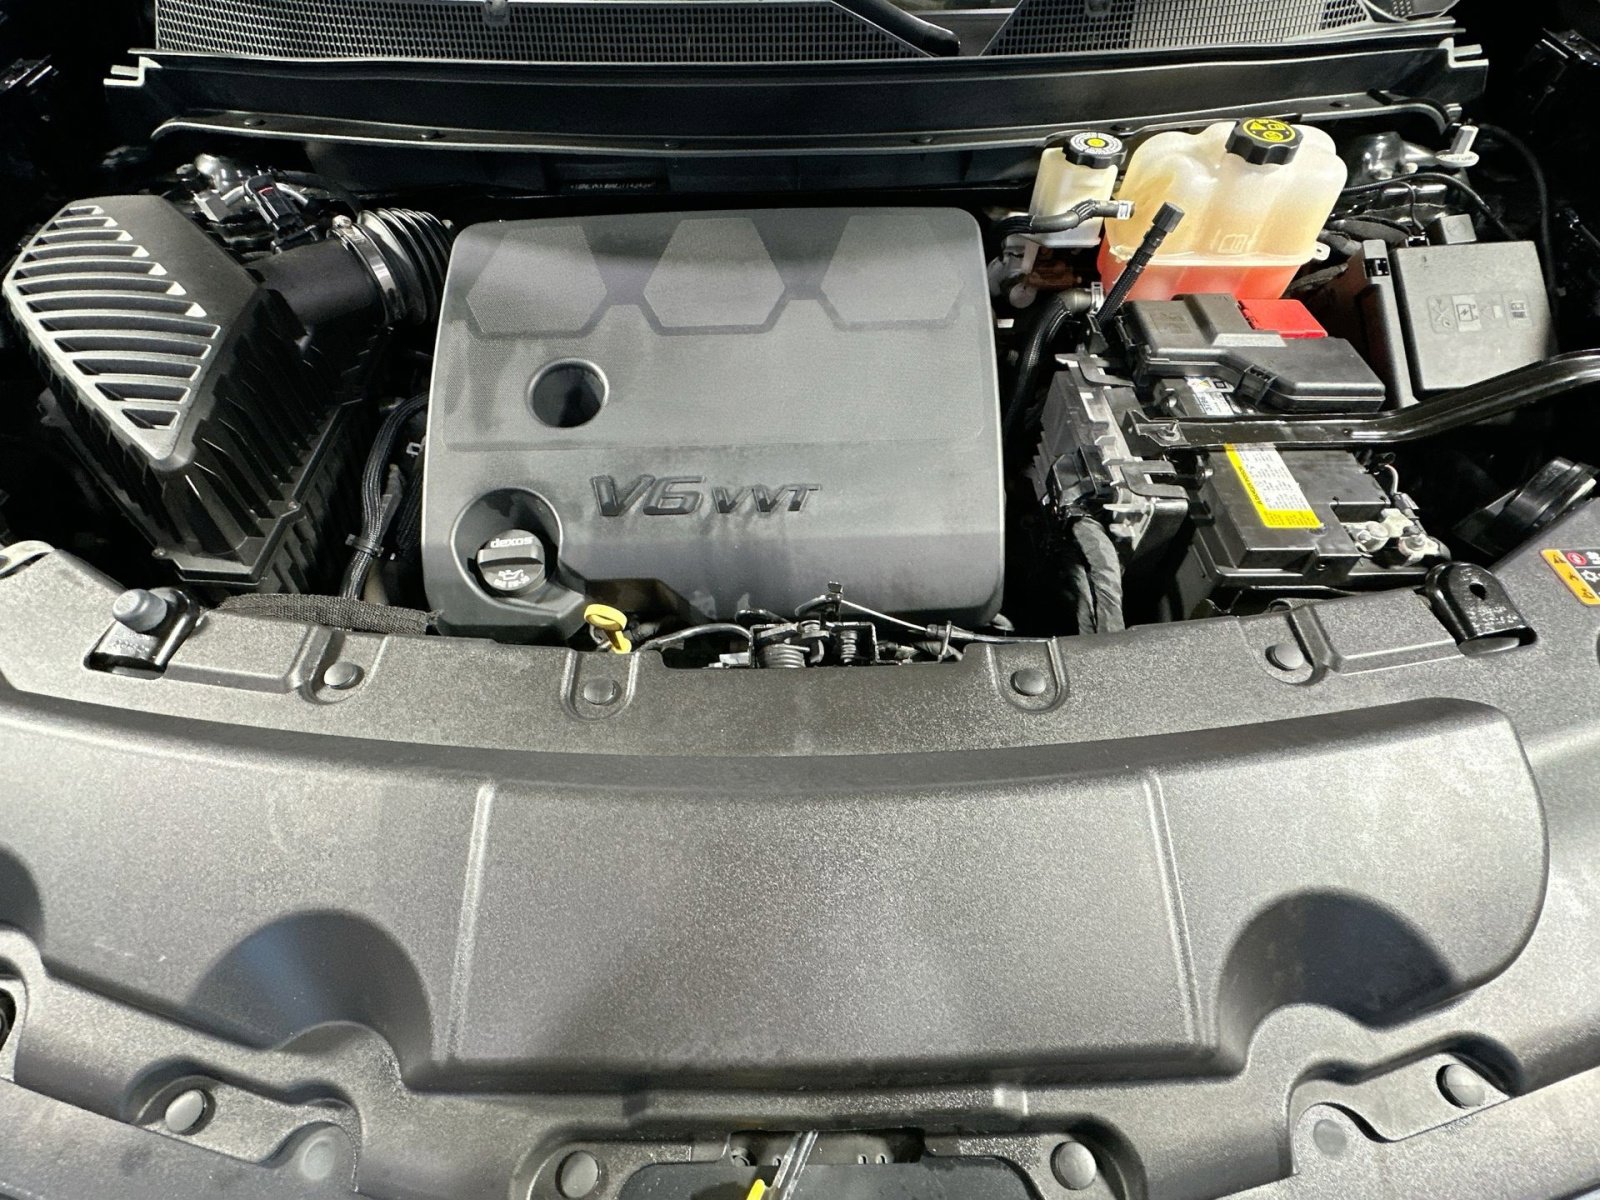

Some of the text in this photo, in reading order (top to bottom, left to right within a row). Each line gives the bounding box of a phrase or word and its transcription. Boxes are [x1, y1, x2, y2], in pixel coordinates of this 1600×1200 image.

[590, 474, 823, 517] V6 VVT
[490, 536, 535, 549] dexos
